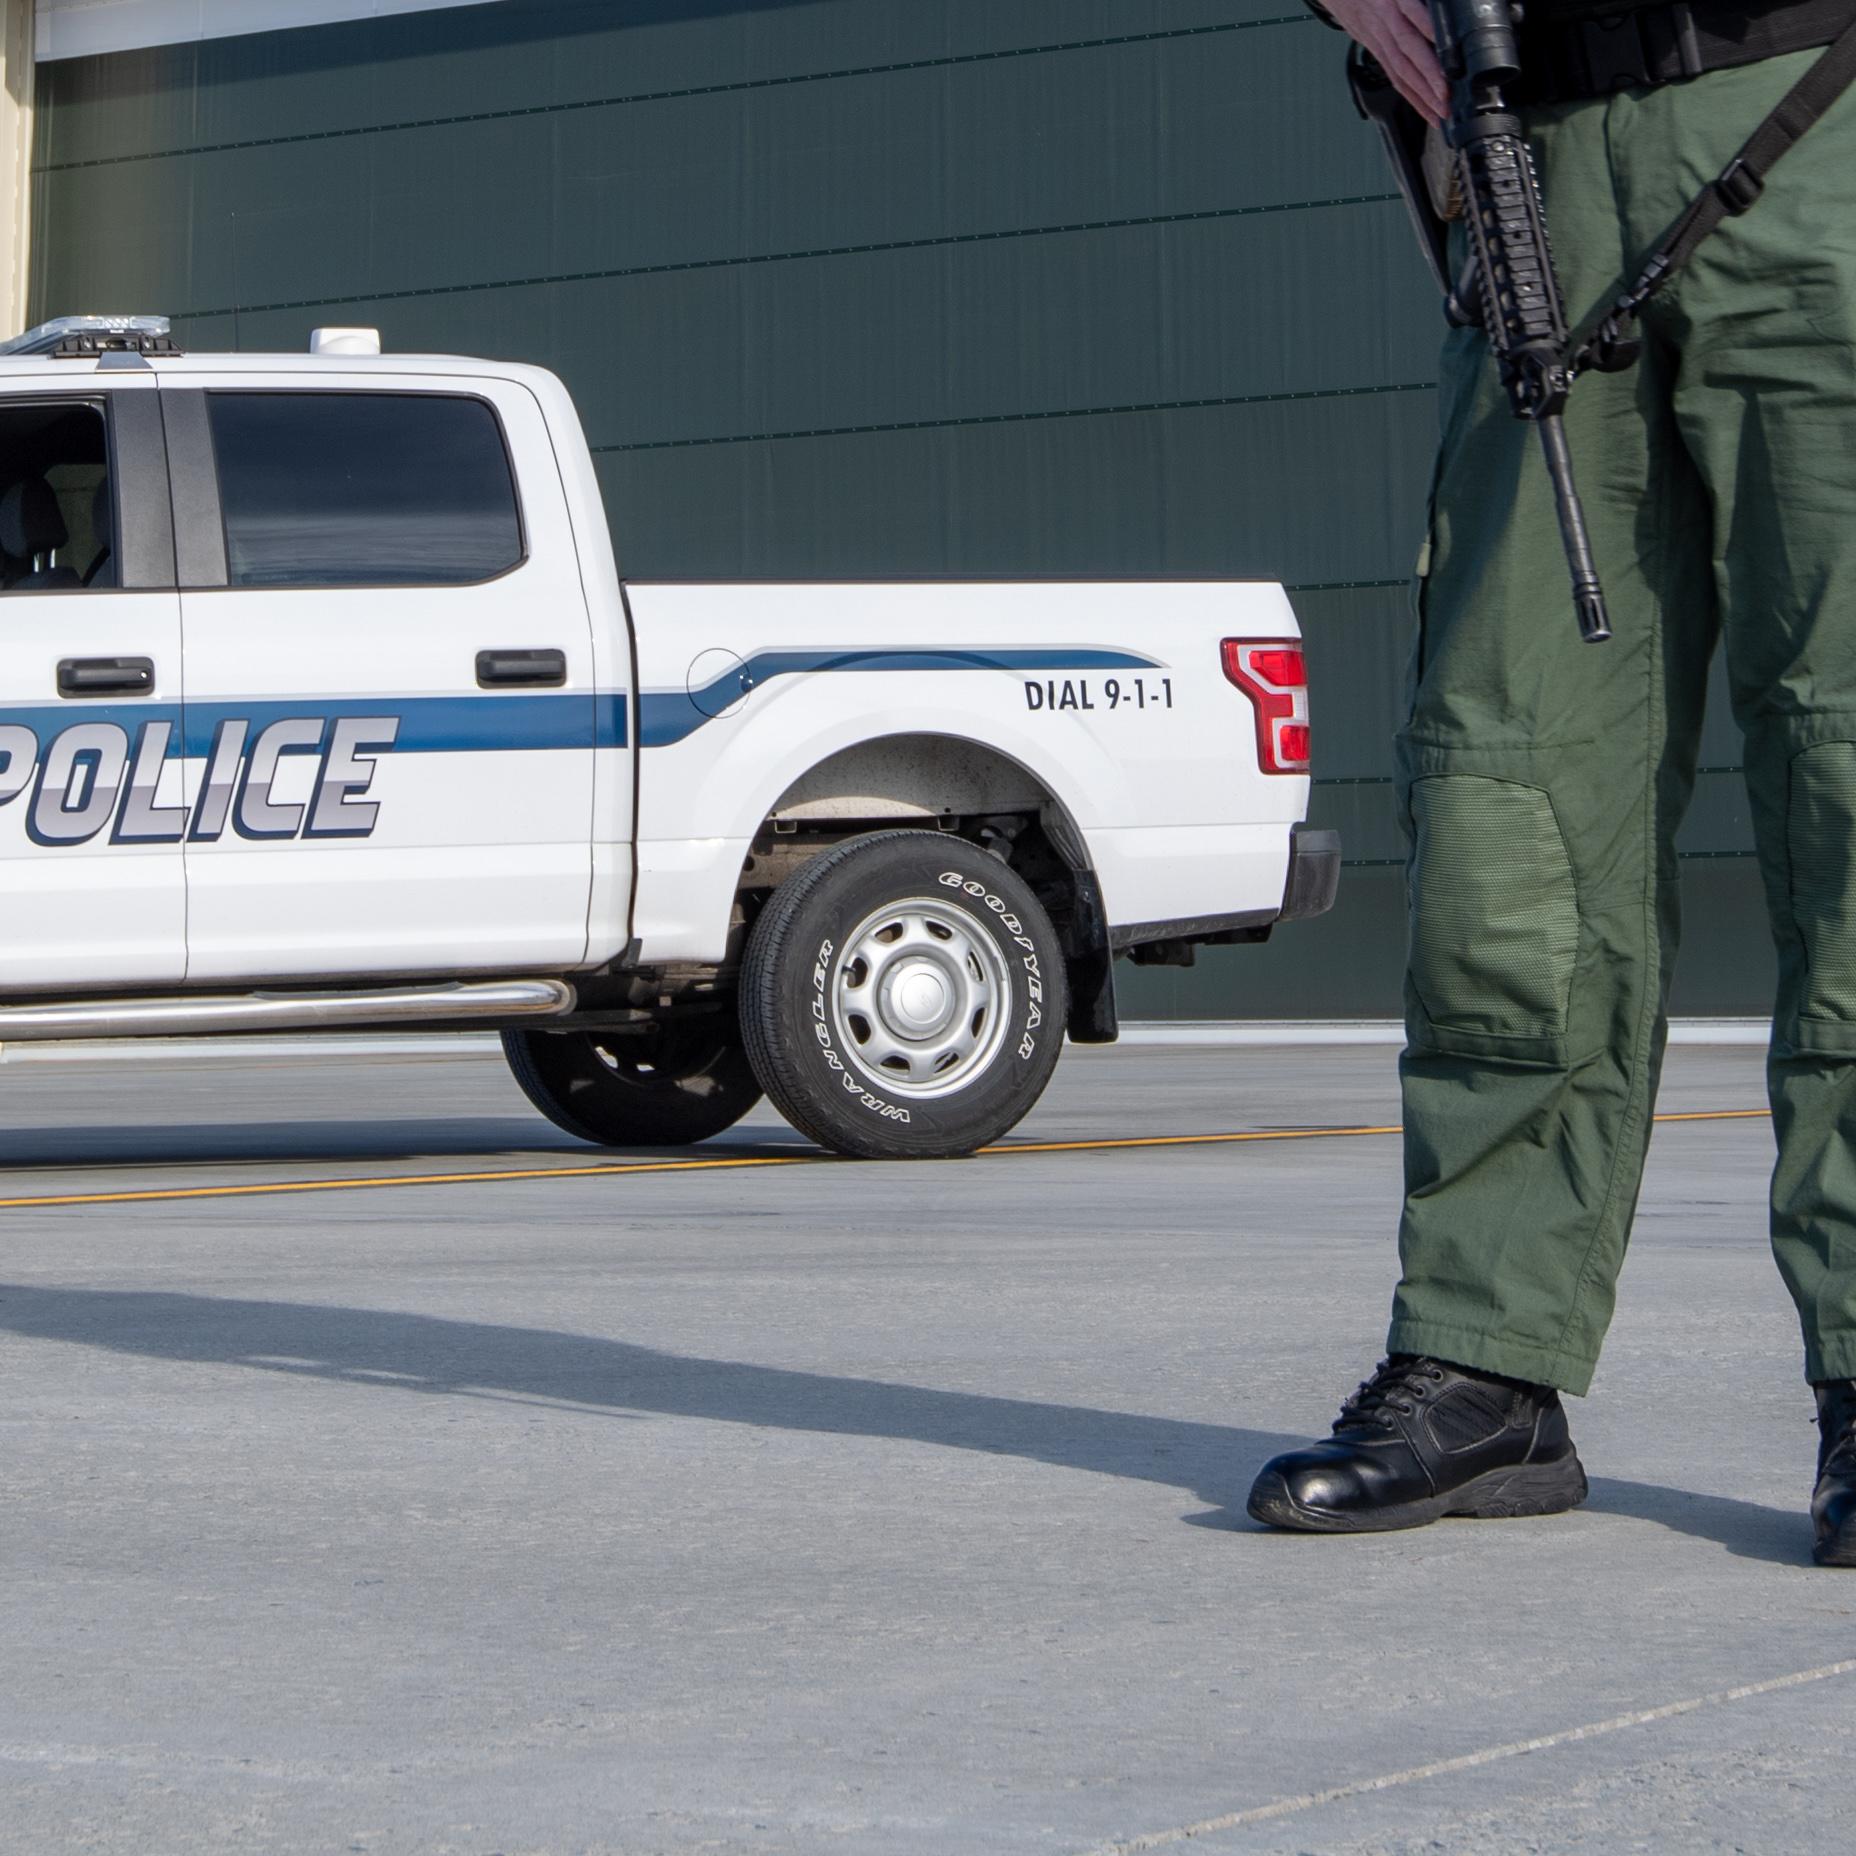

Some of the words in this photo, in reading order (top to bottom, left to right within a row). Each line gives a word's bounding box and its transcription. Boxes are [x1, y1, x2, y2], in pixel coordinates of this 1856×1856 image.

[1024, 680, 1094, 710] DIAL
[1104, 678, 1173, 709] 9-1-1
[812, 939, 911, 1123] WRANGLER
[938, 872, 1042, 1059] GOODYEAR
